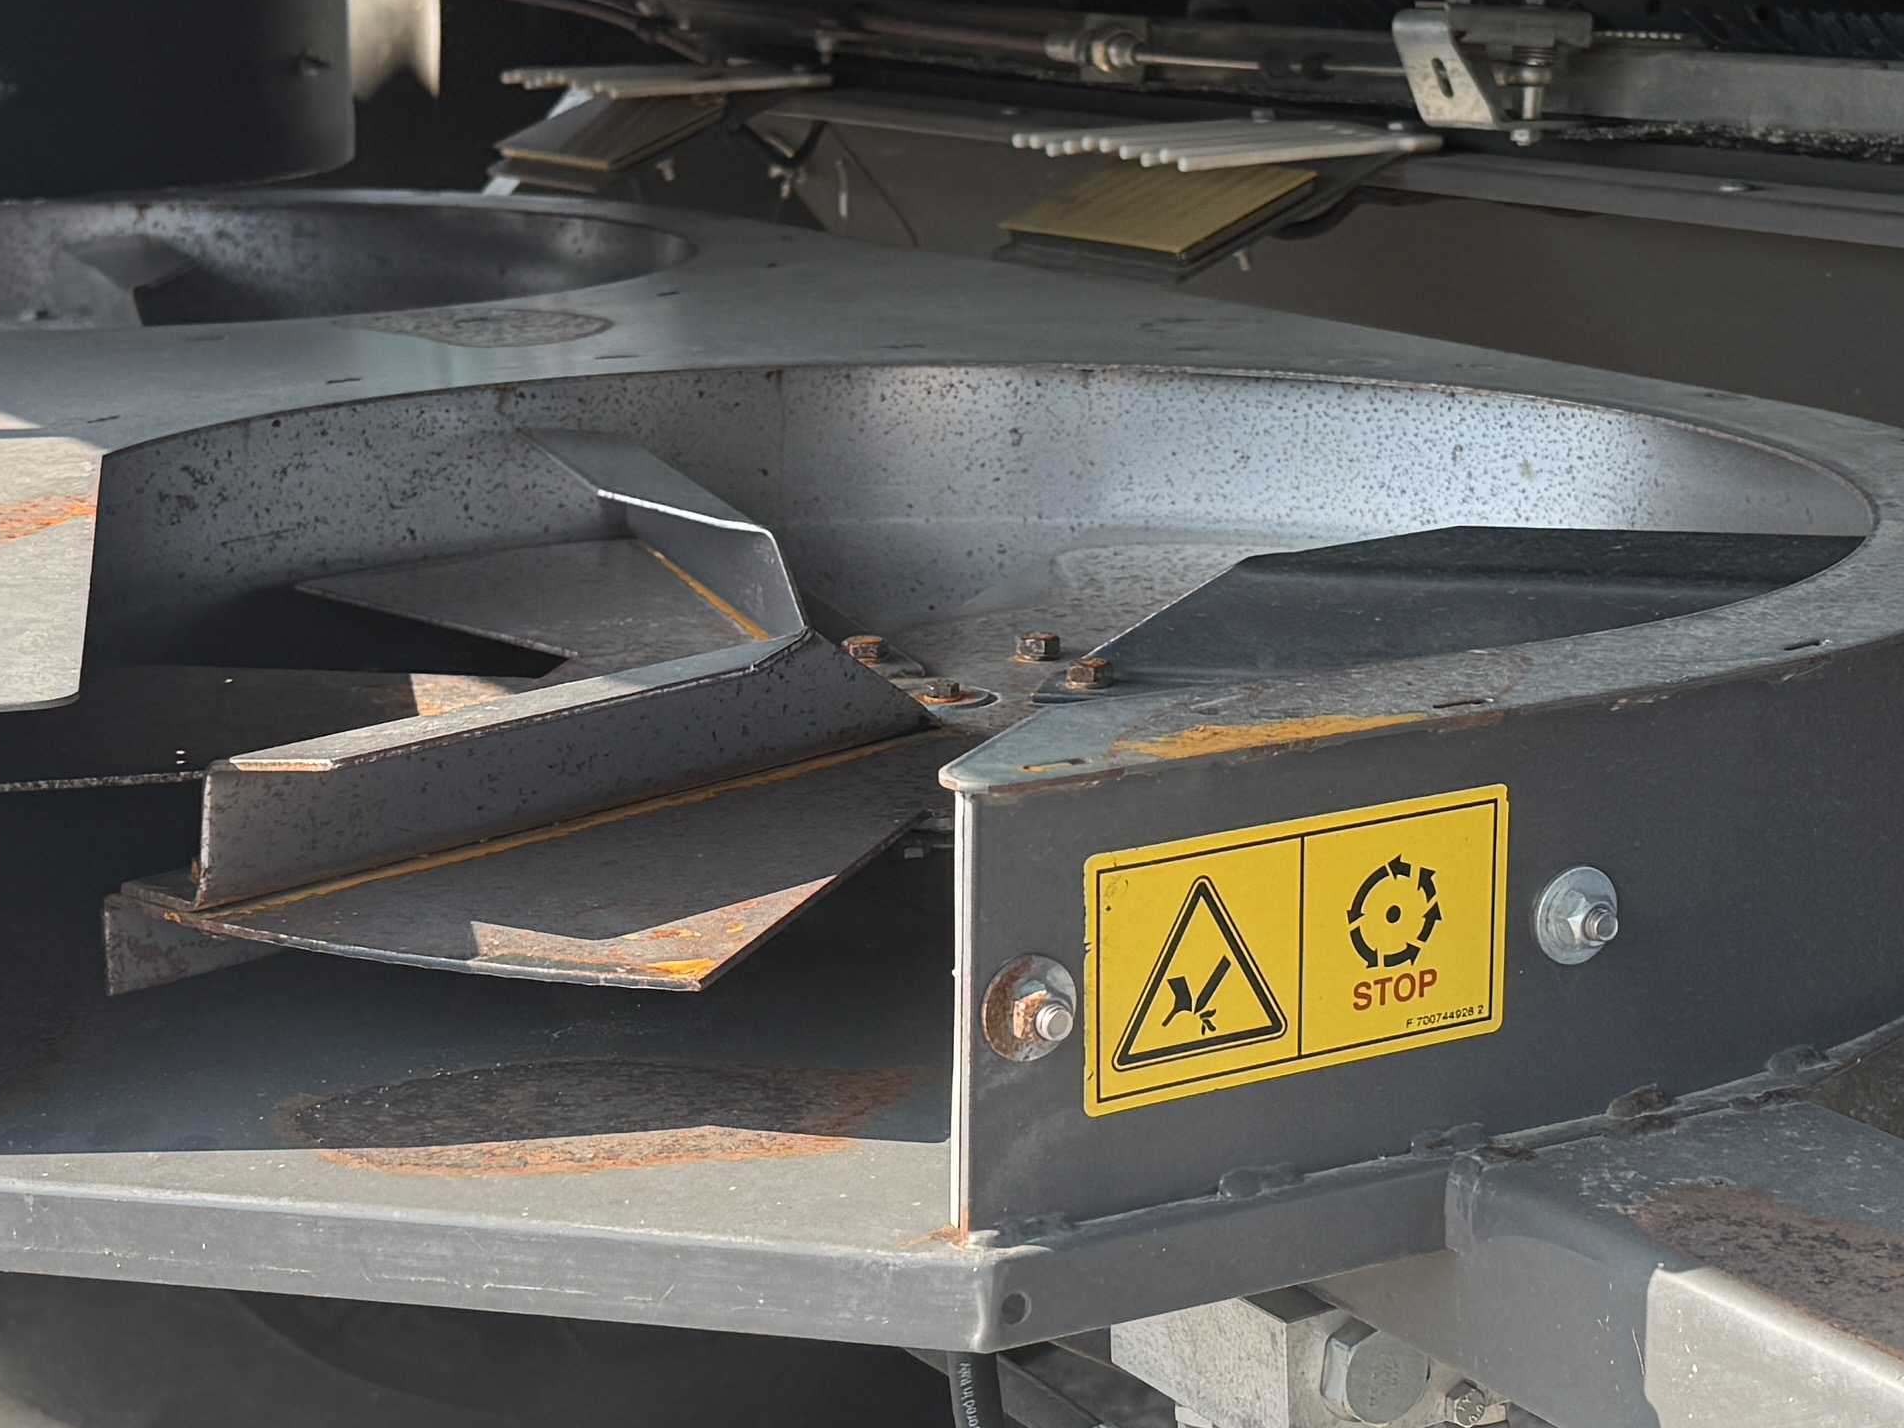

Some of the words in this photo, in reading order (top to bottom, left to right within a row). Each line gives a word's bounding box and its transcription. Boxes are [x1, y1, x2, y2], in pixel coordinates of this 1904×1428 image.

[1352, 968, 1438, 1011] STOP
[1406, 1018, 1414, 1028] F
[1477, 1004, 1485, 1015] 2
